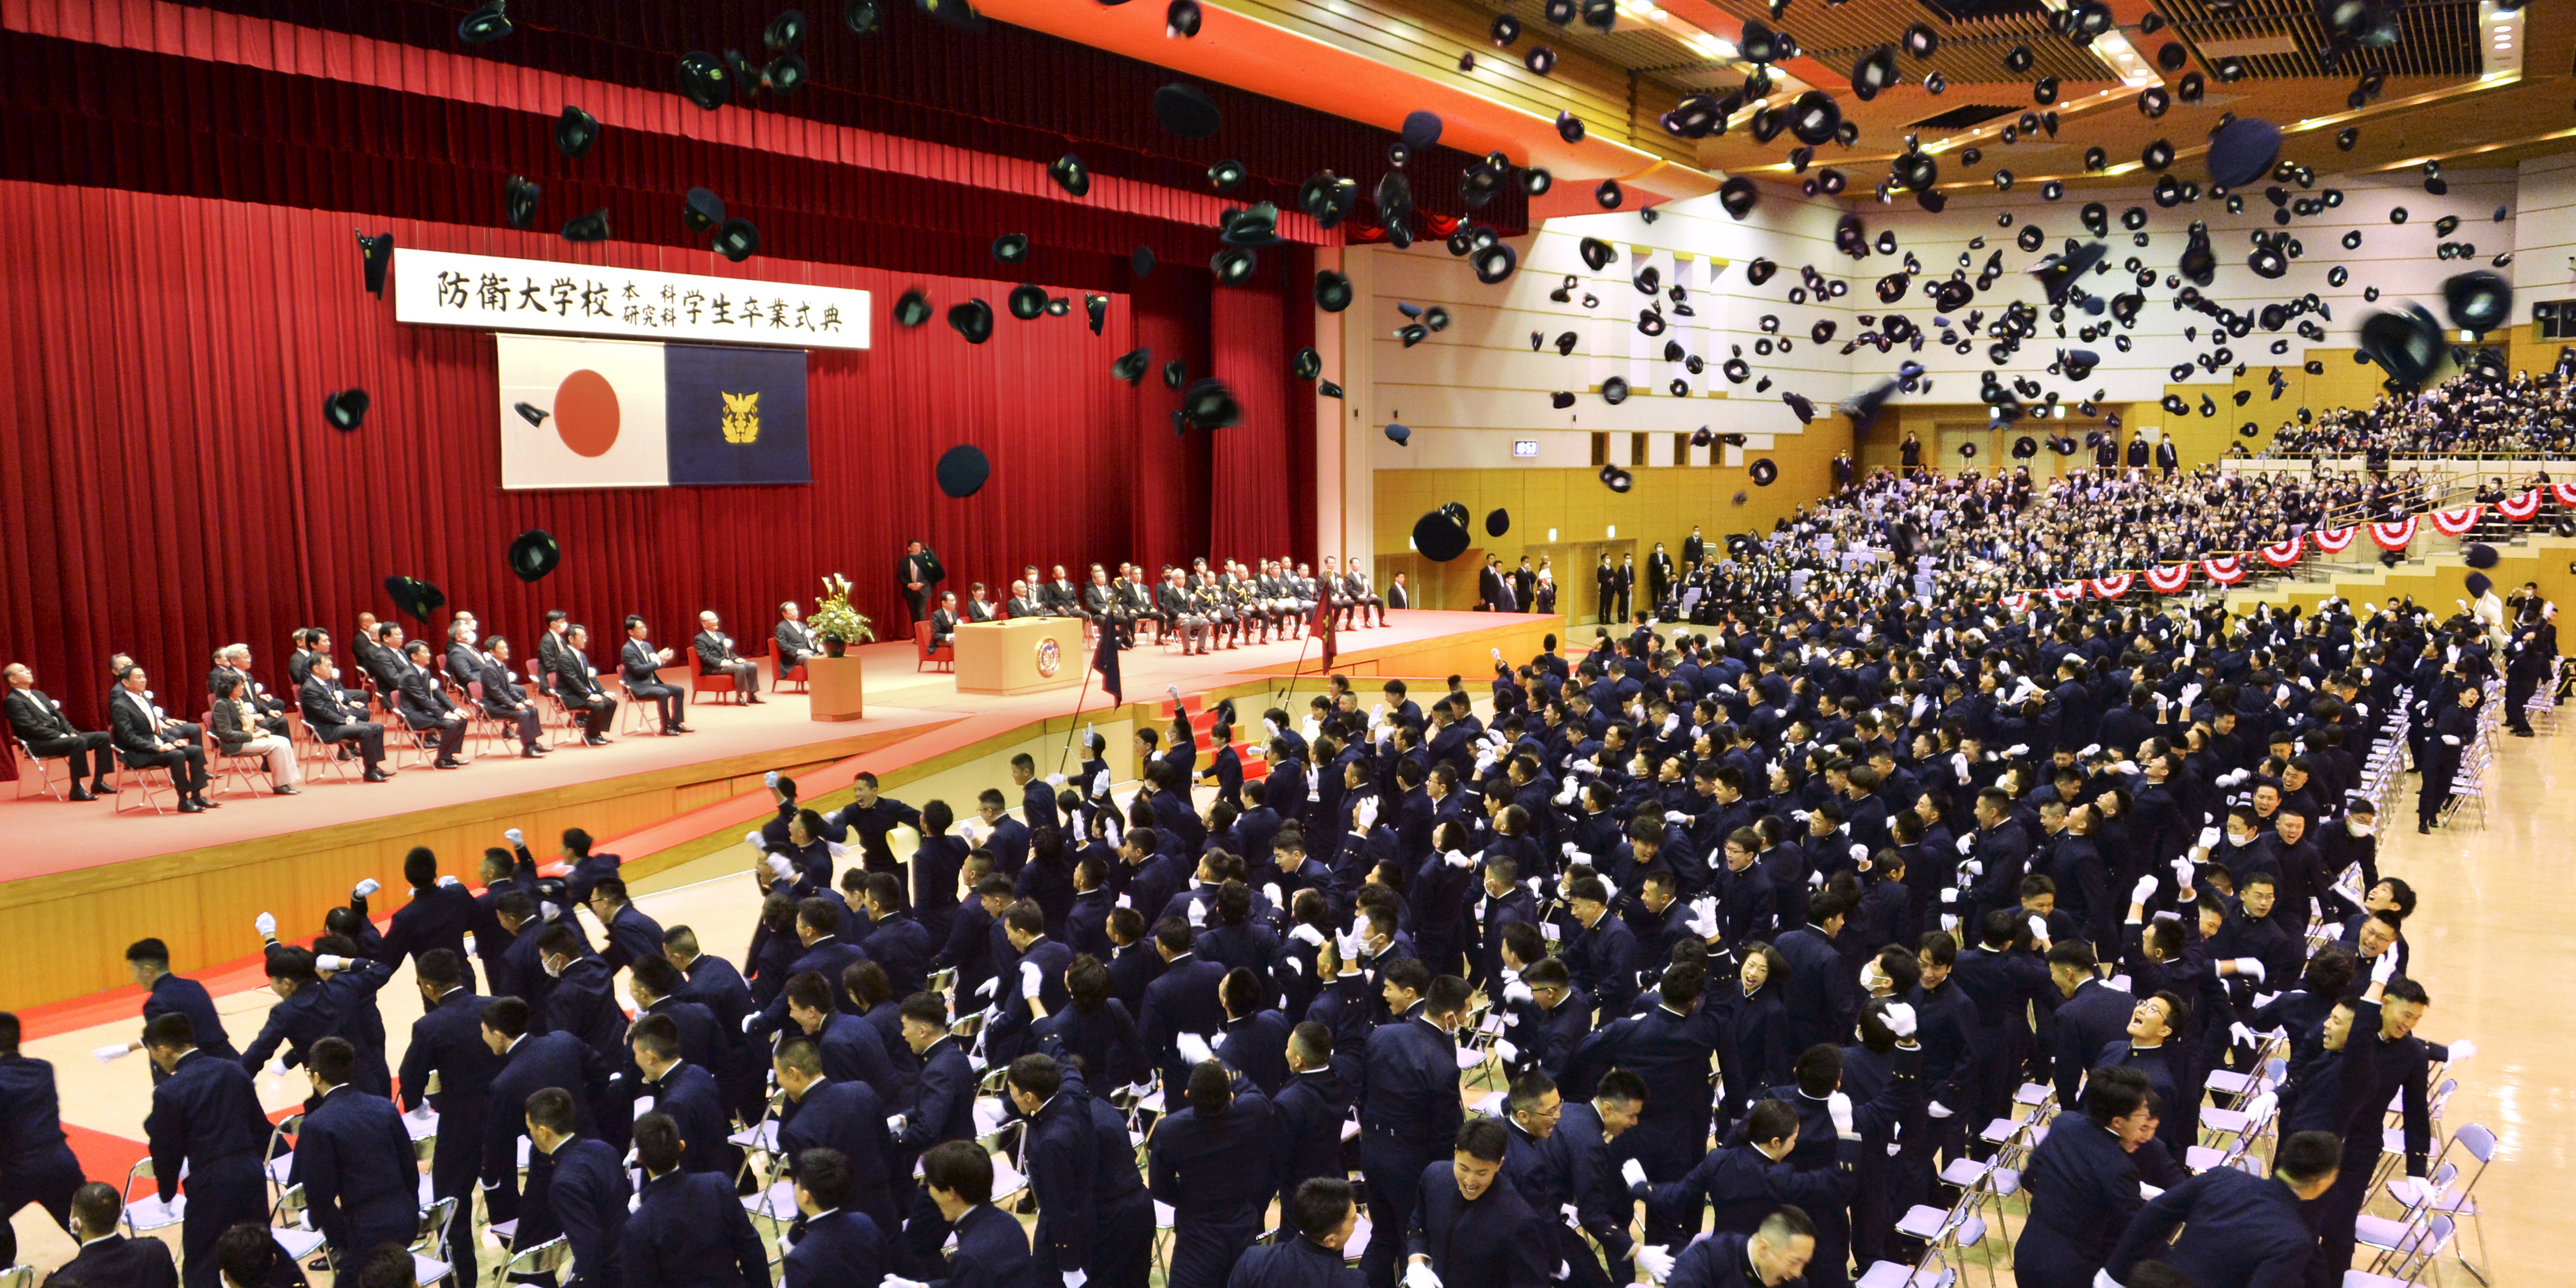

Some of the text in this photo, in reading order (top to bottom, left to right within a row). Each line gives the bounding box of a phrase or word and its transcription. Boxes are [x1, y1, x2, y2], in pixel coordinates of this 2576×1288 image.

[438, 271, 613, 317] 防衛大学校
[683, 289, 842, 332] 学生卒業式典
[622, 304, 676, 328] 研究科
